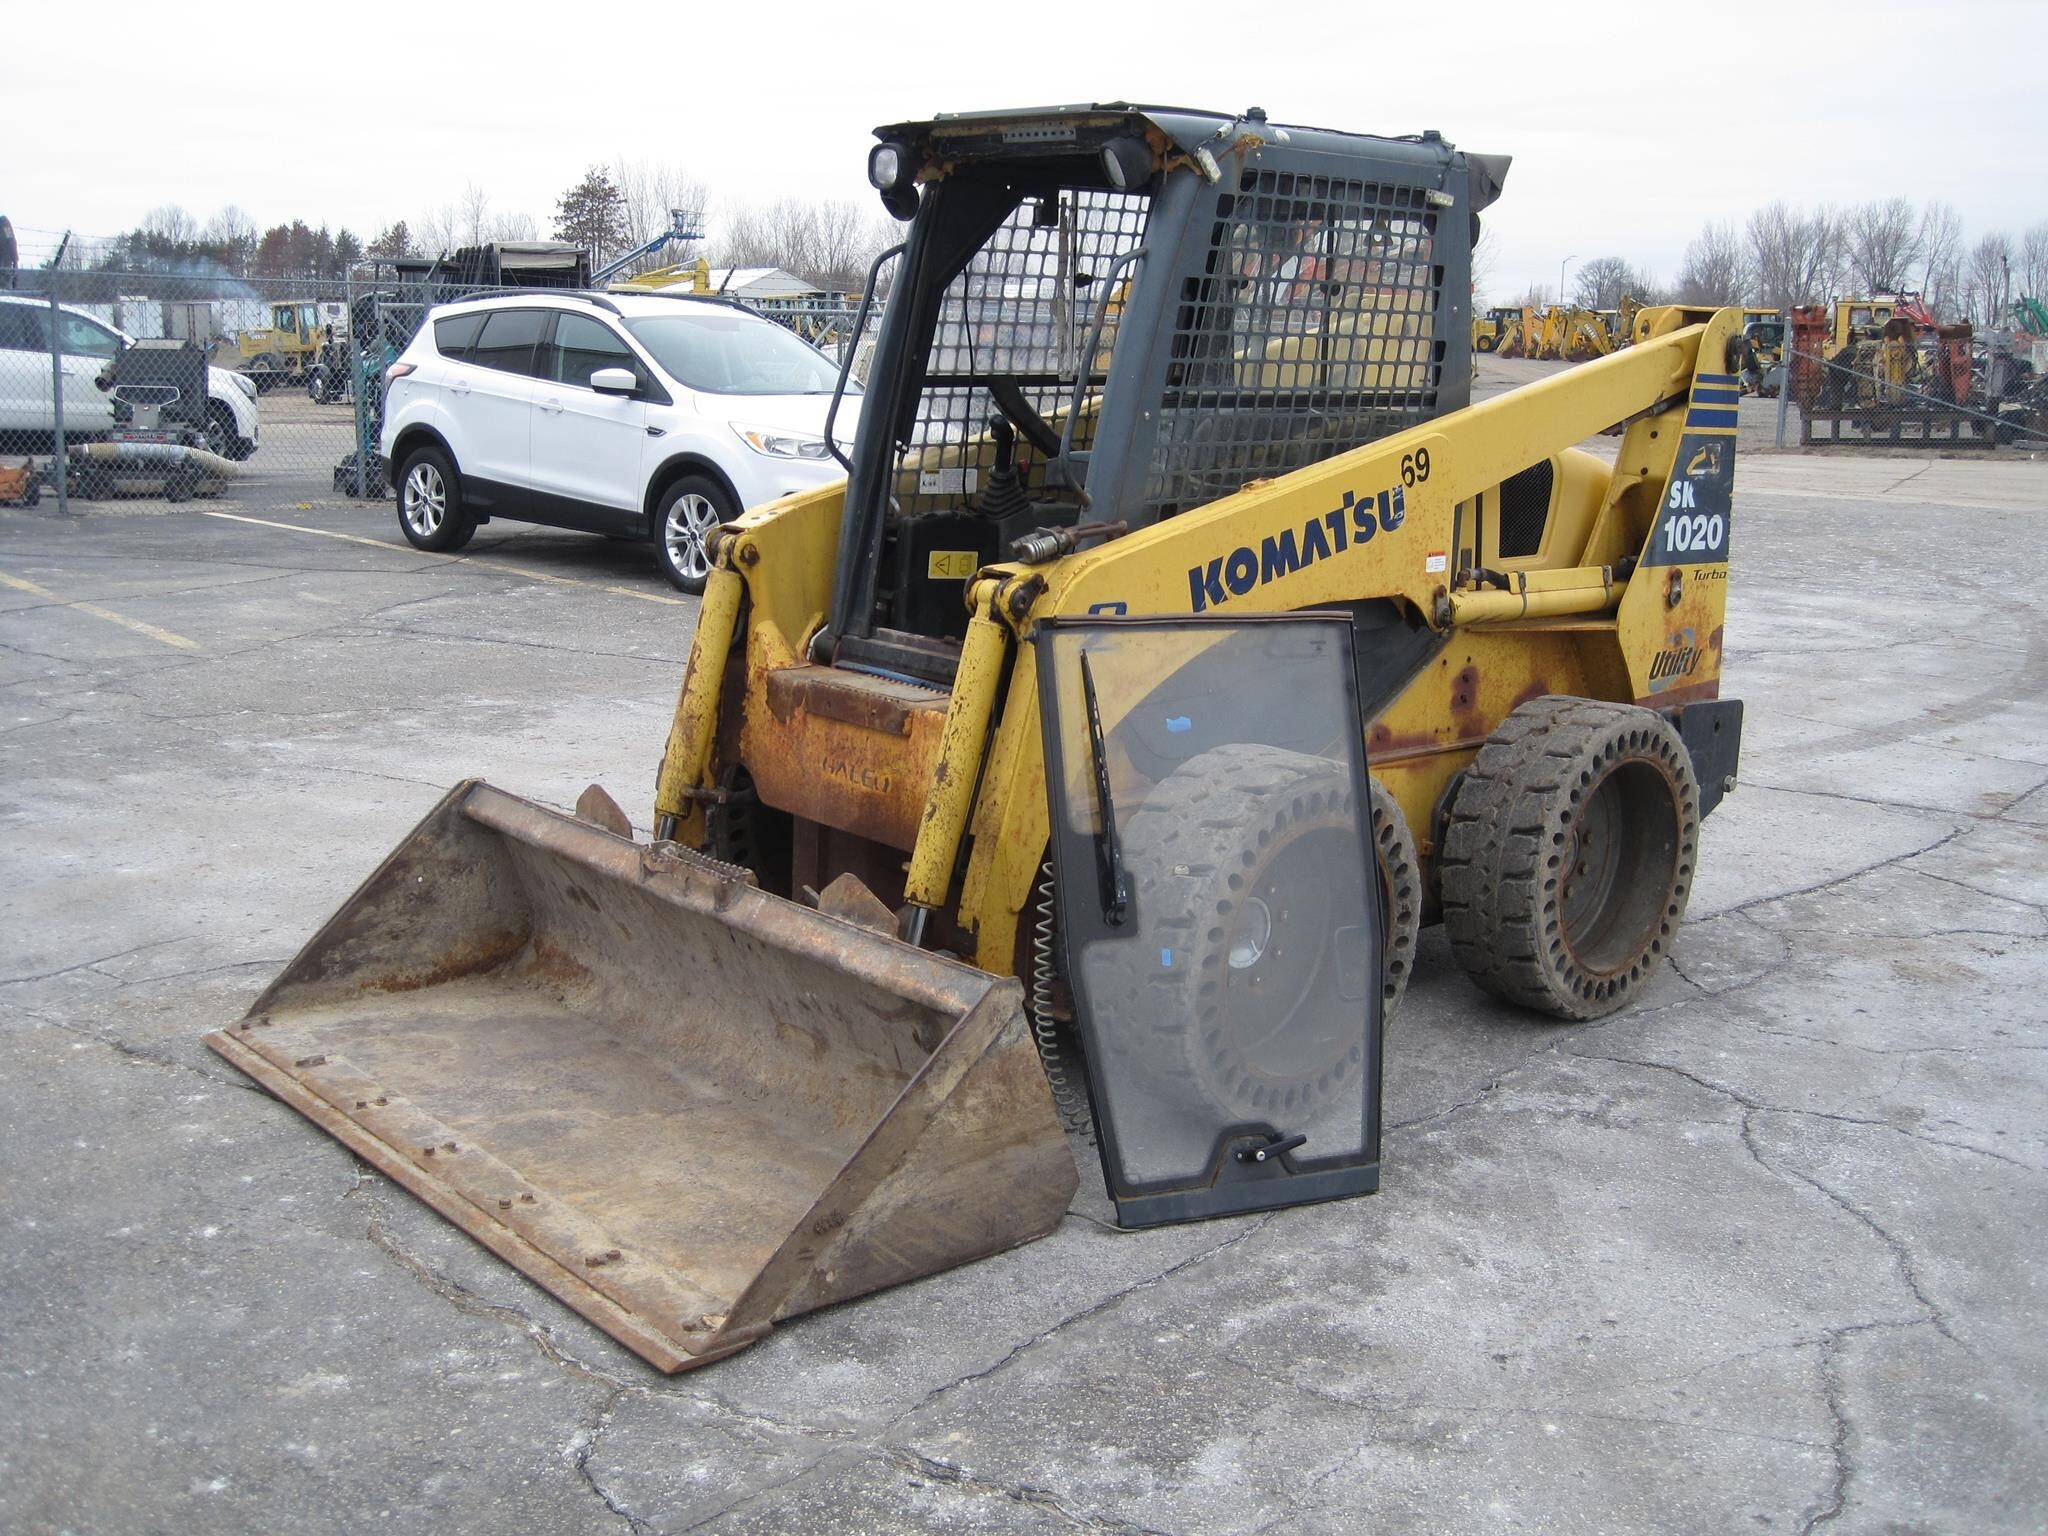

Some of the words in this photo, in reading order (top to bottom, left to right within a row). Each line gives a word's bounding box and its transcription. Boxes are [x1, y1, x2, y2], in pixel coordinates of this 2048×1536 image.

[1401, 447, 1430, 488] 69
[1669, 480, 1695, 508] SK
[1188, 485, 1405, 613] KOMATSU
[1664, 514, 1723, 552] 1020
[1693, 569, 1728, 581] Turbo
[1648, 647, 1703, 680] Utility
